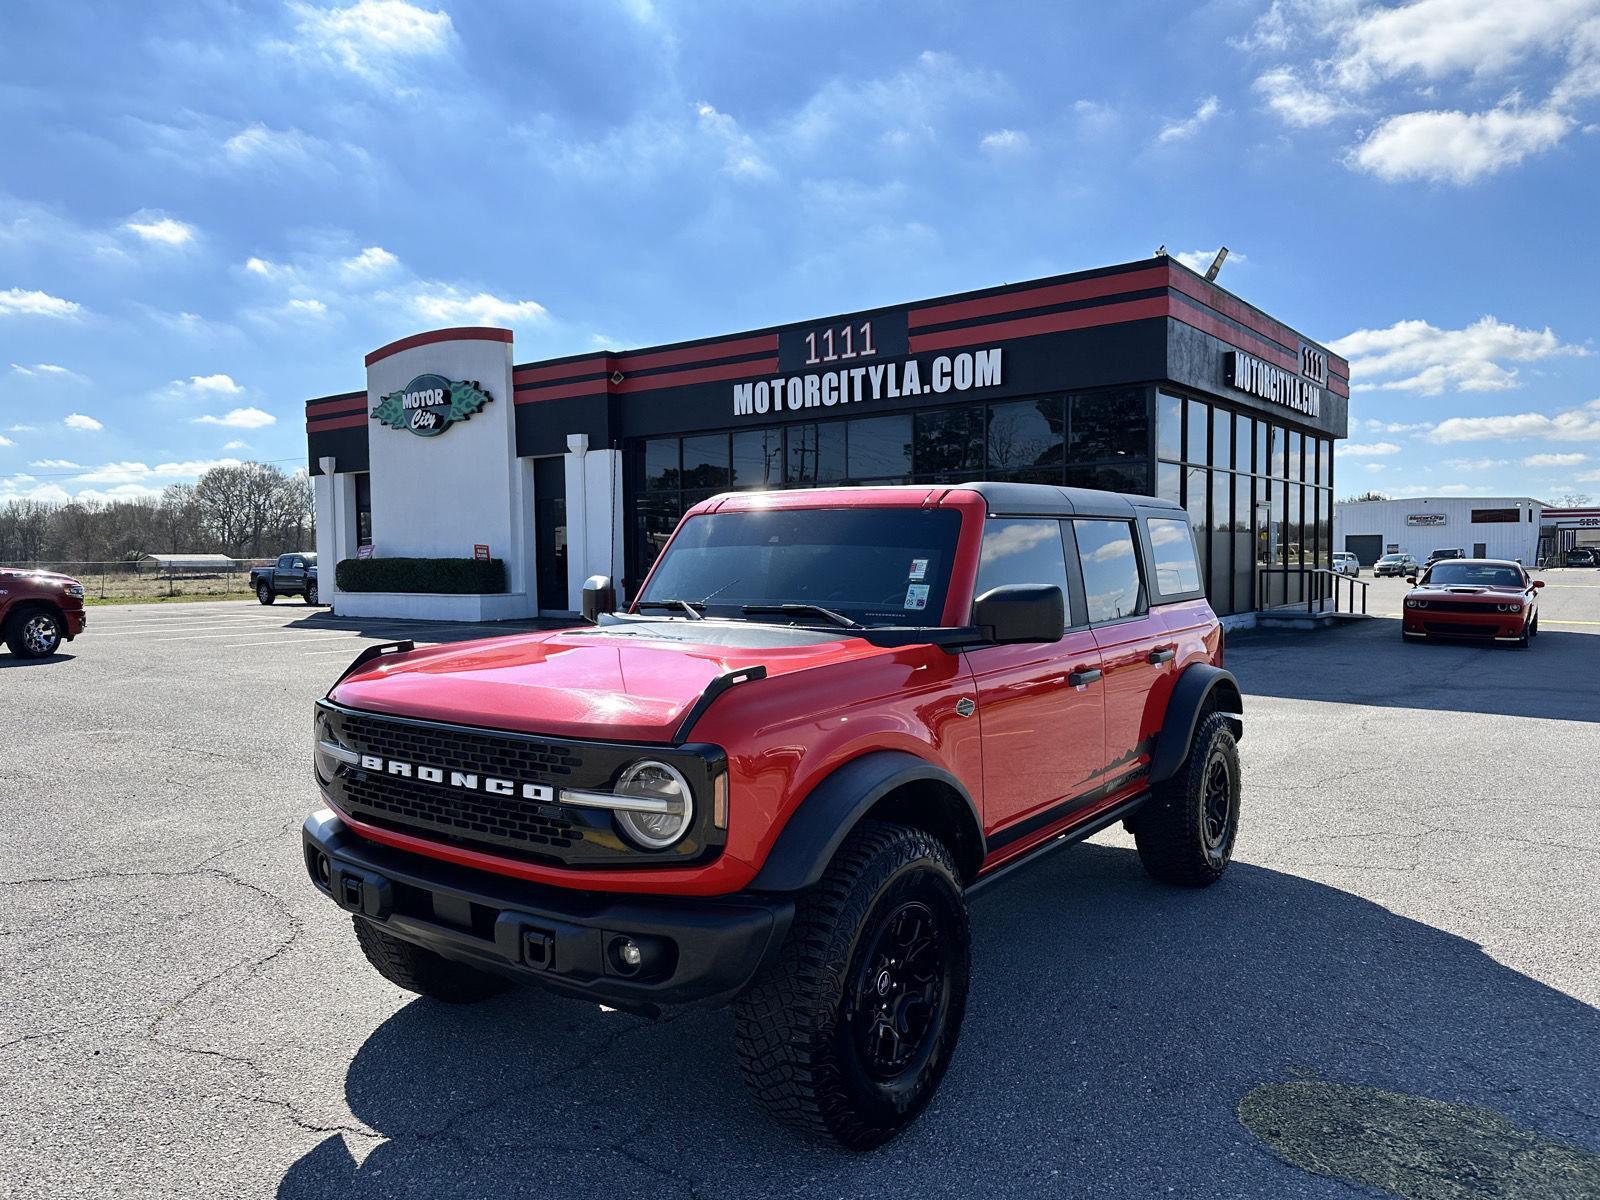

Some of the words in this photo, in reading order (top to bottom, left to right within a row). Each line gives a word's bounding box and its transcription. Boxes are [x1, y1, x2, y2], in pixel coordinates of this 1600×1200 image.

[805, 321, 877, 365] 1111
[1303, 346, 1324, 383] 1111
[402, 388, 444, 410] MOTOR
[733, 348, 1003, 416] MOTORCITYLA.COM
[1234, 350, 1320, 418] MOTORCITYLA.COM
[410, 409, 436, 429] City
[361, 754, 555, 802] BRONCO
